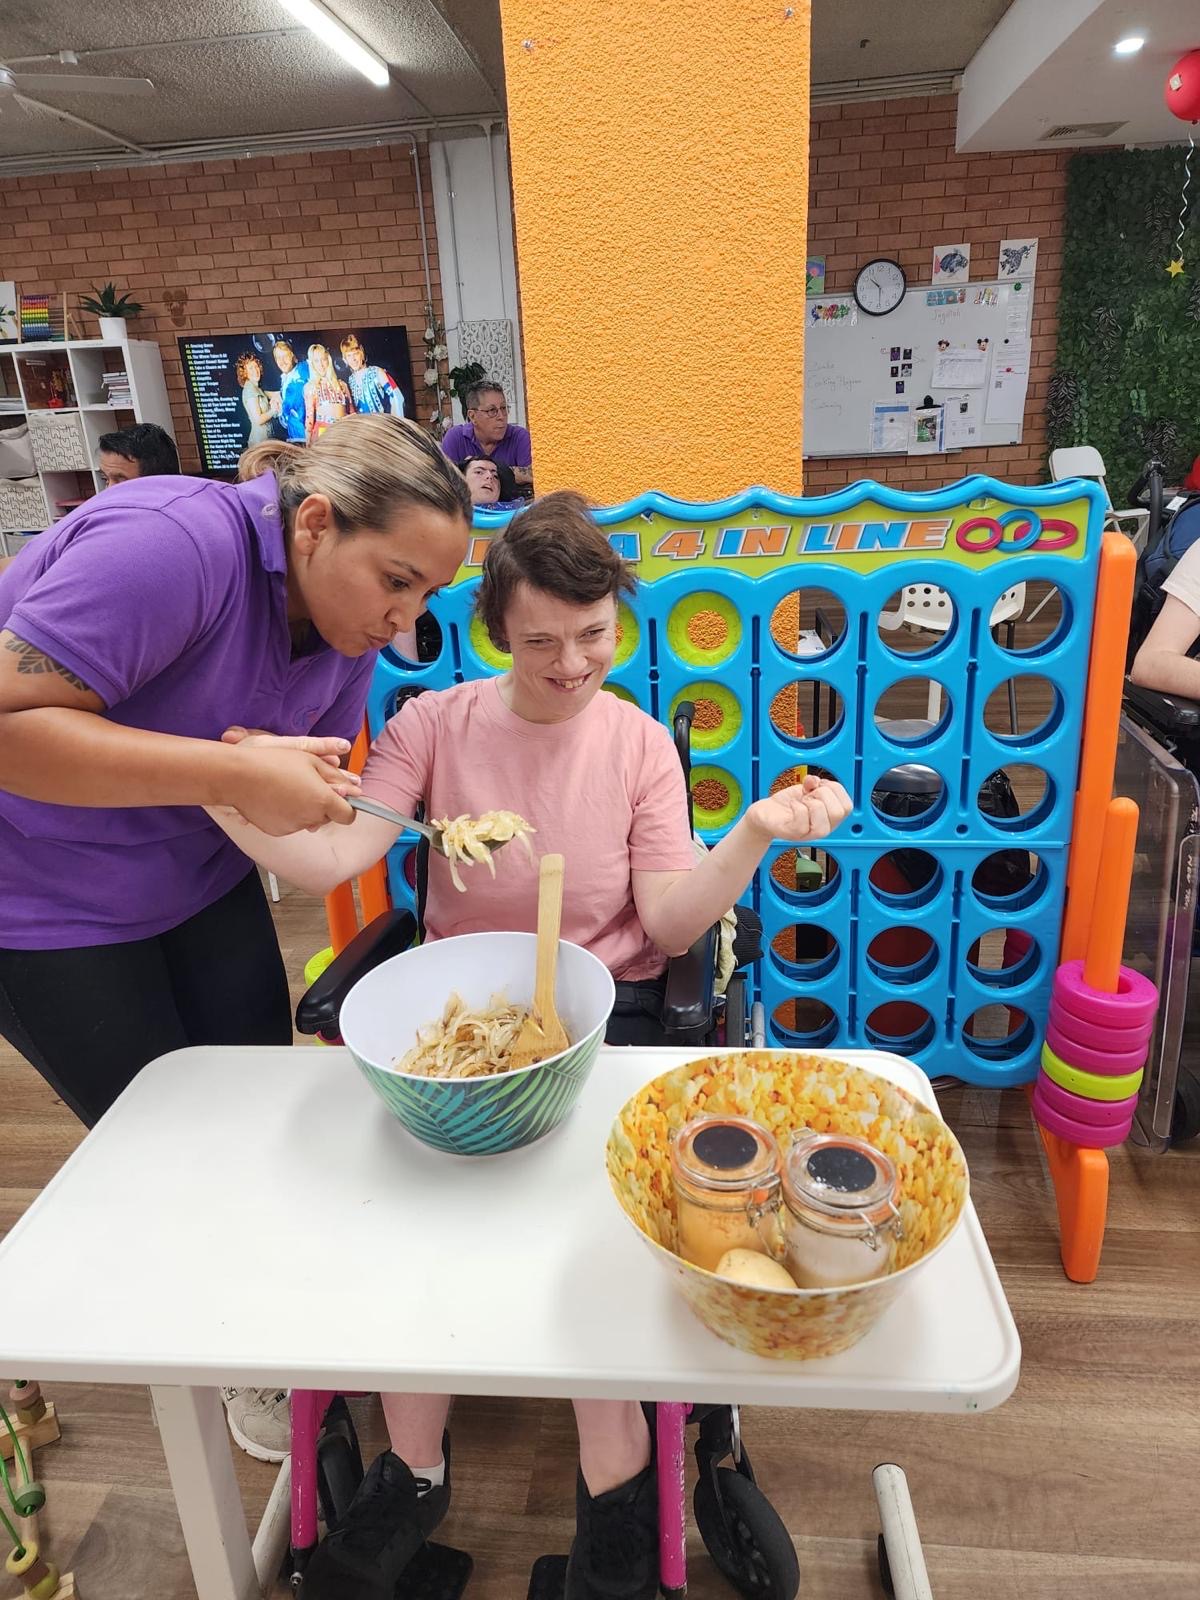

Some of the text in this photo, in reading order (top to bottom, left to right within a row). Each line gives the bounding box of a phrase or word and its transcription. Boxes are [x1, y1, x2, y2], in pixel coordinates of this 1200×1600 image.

[651, 530, 705, 560] 4
[712, 526, 793, 559] IN
[799, 519, 953, 555] LINE
